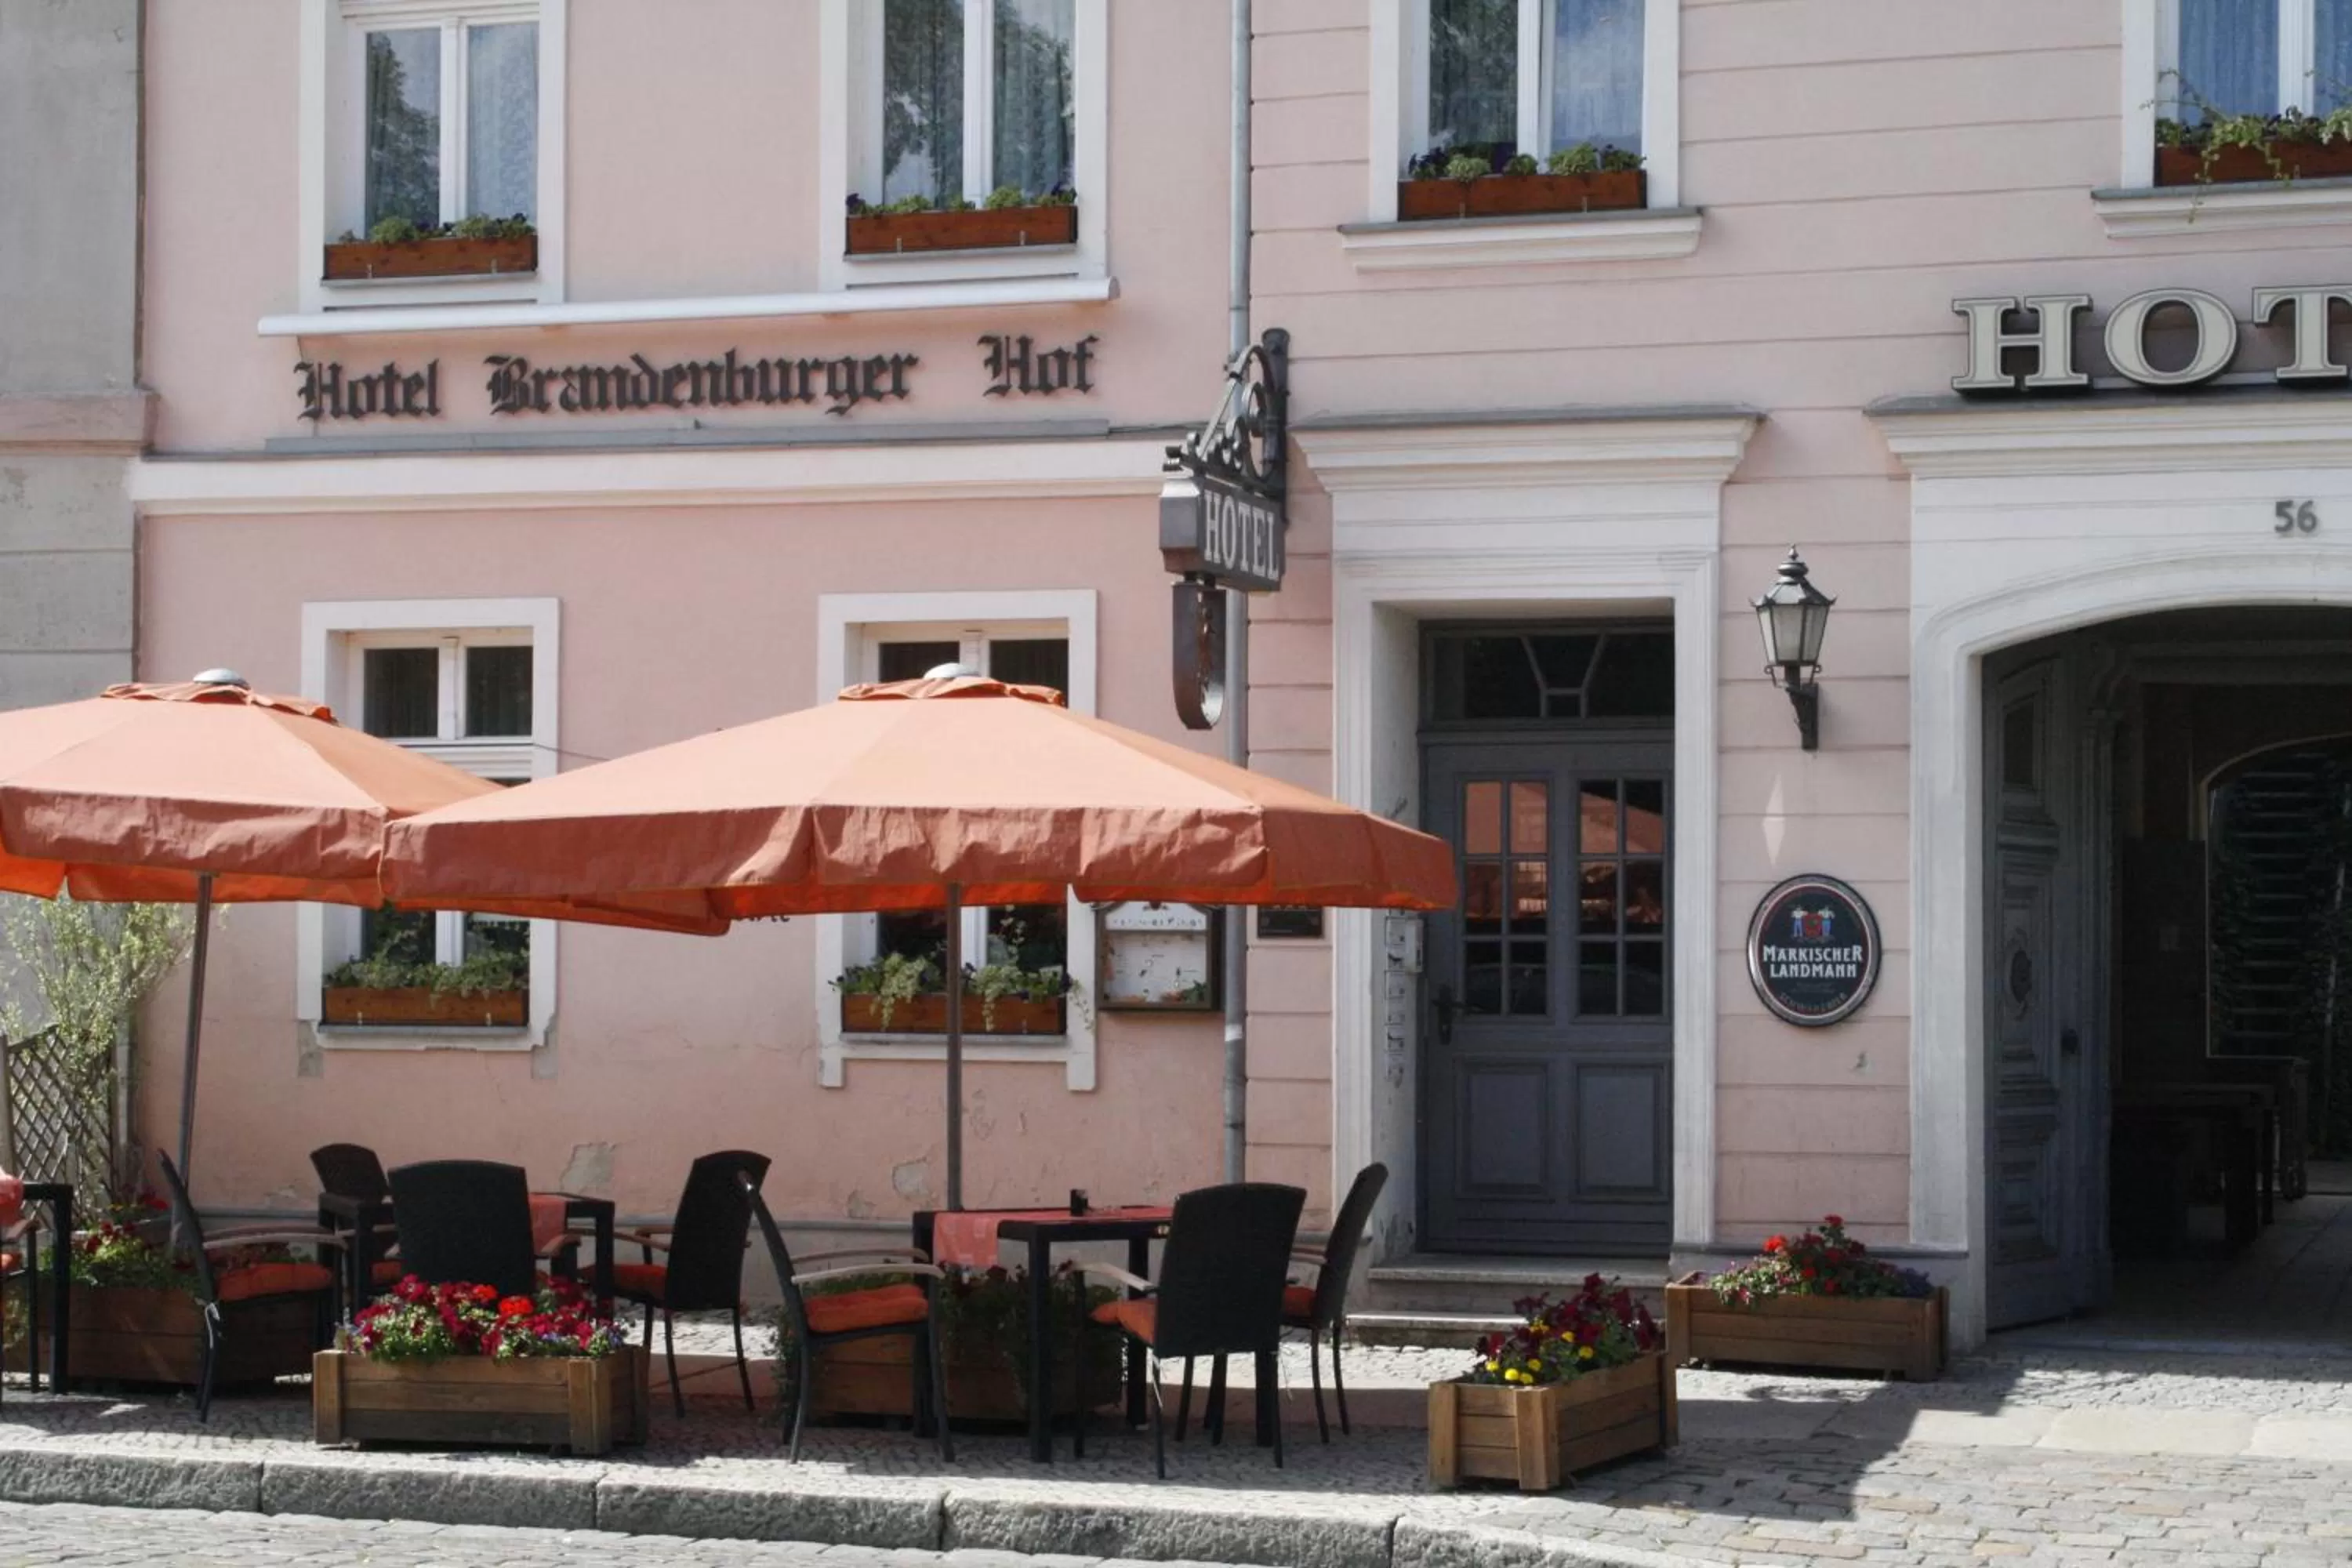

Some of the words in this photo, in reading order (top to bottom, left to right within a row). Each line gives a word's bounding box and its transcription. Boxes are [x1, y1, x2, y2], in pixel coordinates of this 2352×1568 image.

[293, 358, 441, 420] Hotel
[483, 346, 920, 416] Brandenburger
[977, 334, 1099, 397] Hof
[1203, 491, 1279, 583] HOTEL
[2274, 500, 2318, 533] 56
[1770, 963, 1857, 978] LANDMANN
